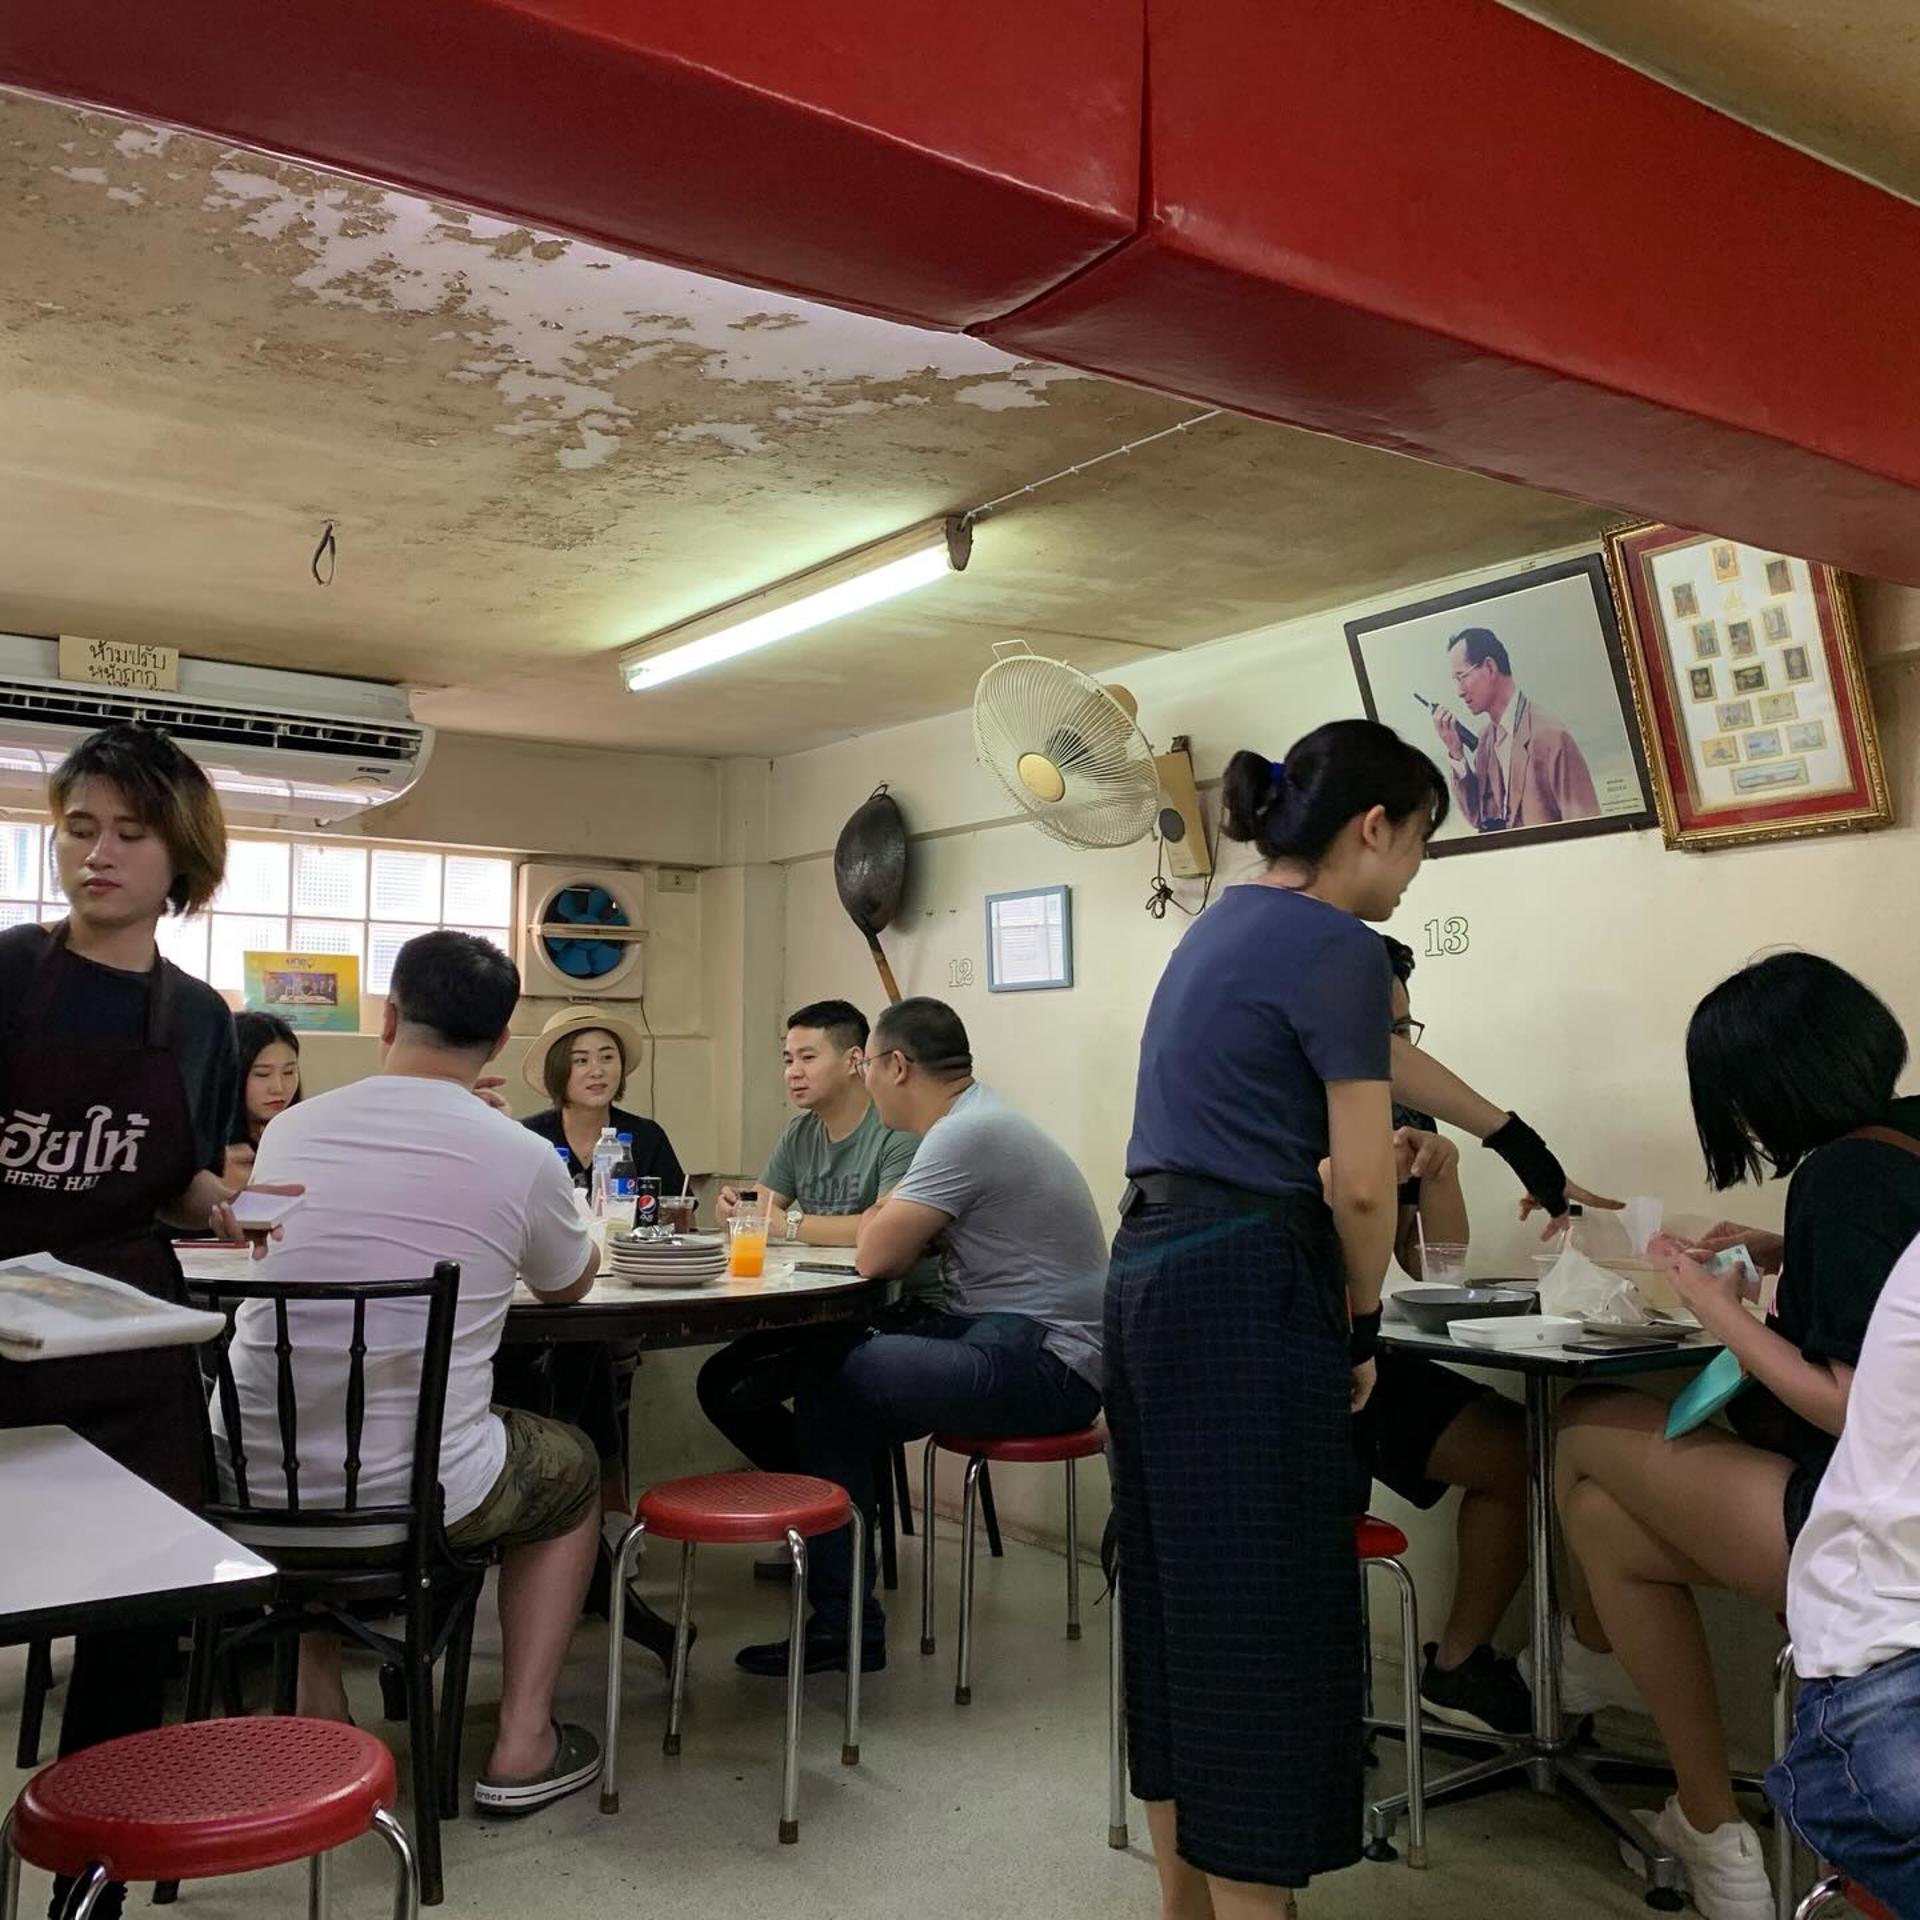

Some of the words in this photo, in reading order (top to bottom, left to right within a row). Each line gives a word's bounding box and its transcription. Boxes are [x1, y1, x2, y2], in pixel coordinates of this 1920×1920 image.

[88, 640, 166, 670] ห้ามปรับ
[1424, 916, 1470, 957] 13
[949, 958, 974, 988] 12
[4, 1169, 60, 1190] HERE
[476, 1791, 503, 1802] crocs
